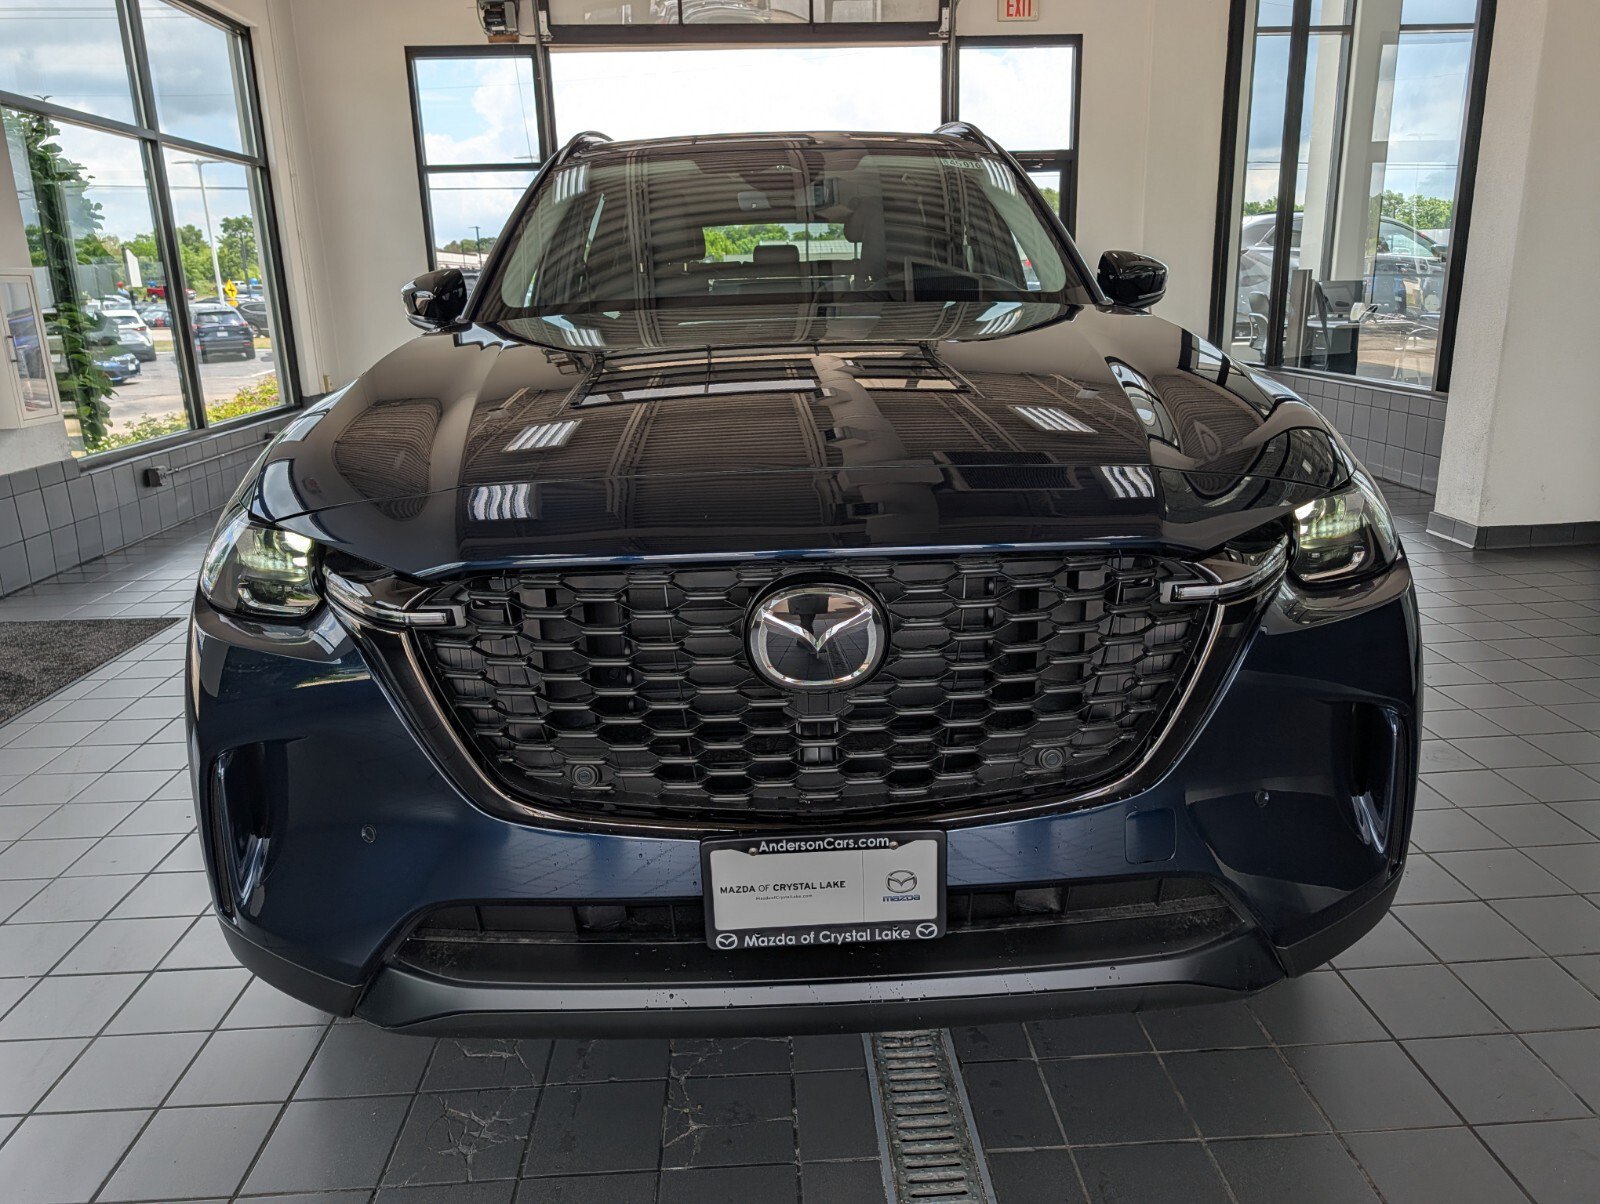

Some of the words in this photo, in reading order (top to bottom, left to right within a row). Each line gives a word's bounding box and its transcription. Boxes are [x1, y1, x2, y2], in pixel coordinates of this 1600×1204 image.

[759, 837, 890, 852] AndersonCars.com
[720, 885, 756, 894] MAZDA
[758, 884, 770, 892] OF
[773, 882, 817, 892] CRYSTAL
[819, 880, 846, 890] LAKE
[744, 933, 796, 948] Mazda
[800, 931, 815, 944] of
[819, 928, 870, 945] Crystal
[875, 927, 911, 941] Lake
